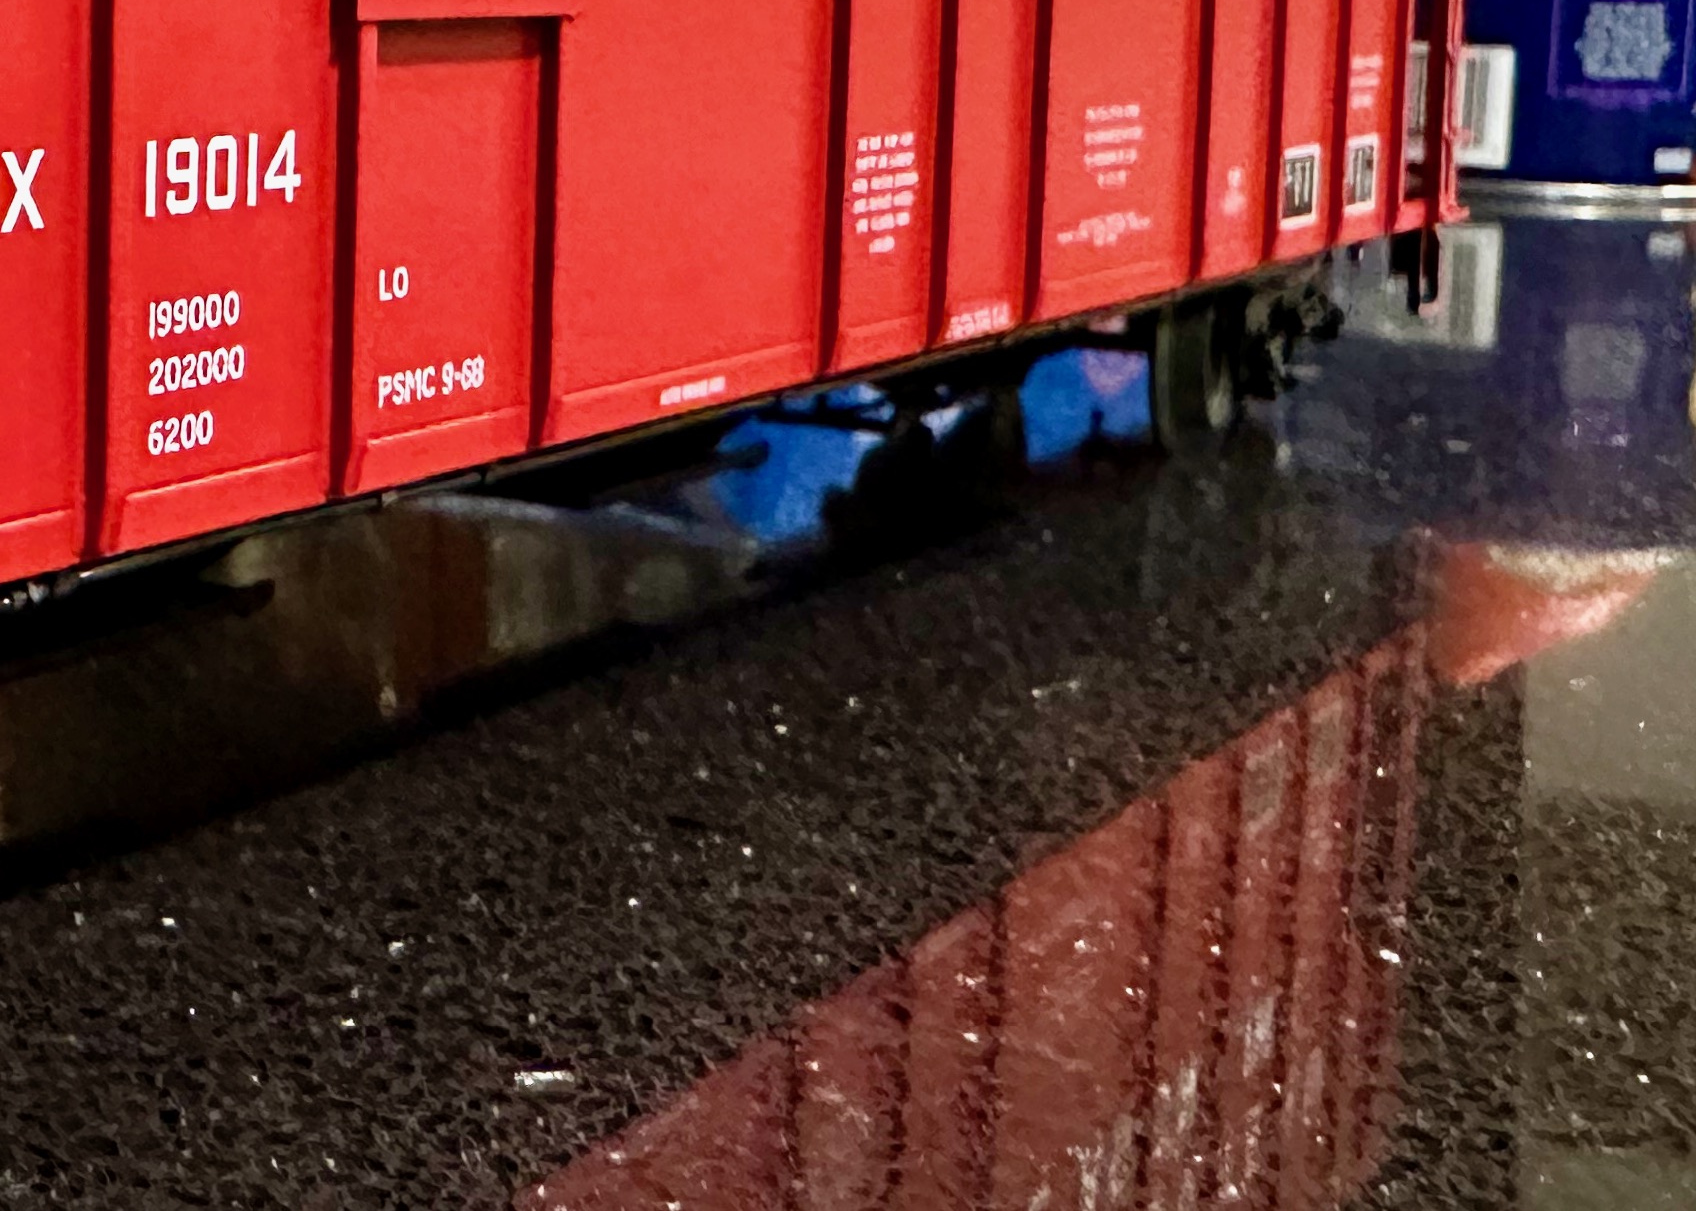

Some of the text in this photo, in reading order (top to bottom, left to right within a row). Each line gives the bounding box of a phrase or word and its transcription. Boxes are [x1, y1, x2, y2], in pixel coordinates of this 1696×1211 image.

[145, 129, 302, 218] 19014
[378, 266, 409, 301] LO
[148, 290, 241, 340] 199000
[148, 344, 245, 396] 202000
[377, 354, 486, 409] PSMC 9-68
[147, 410, 214, 456] 6200
